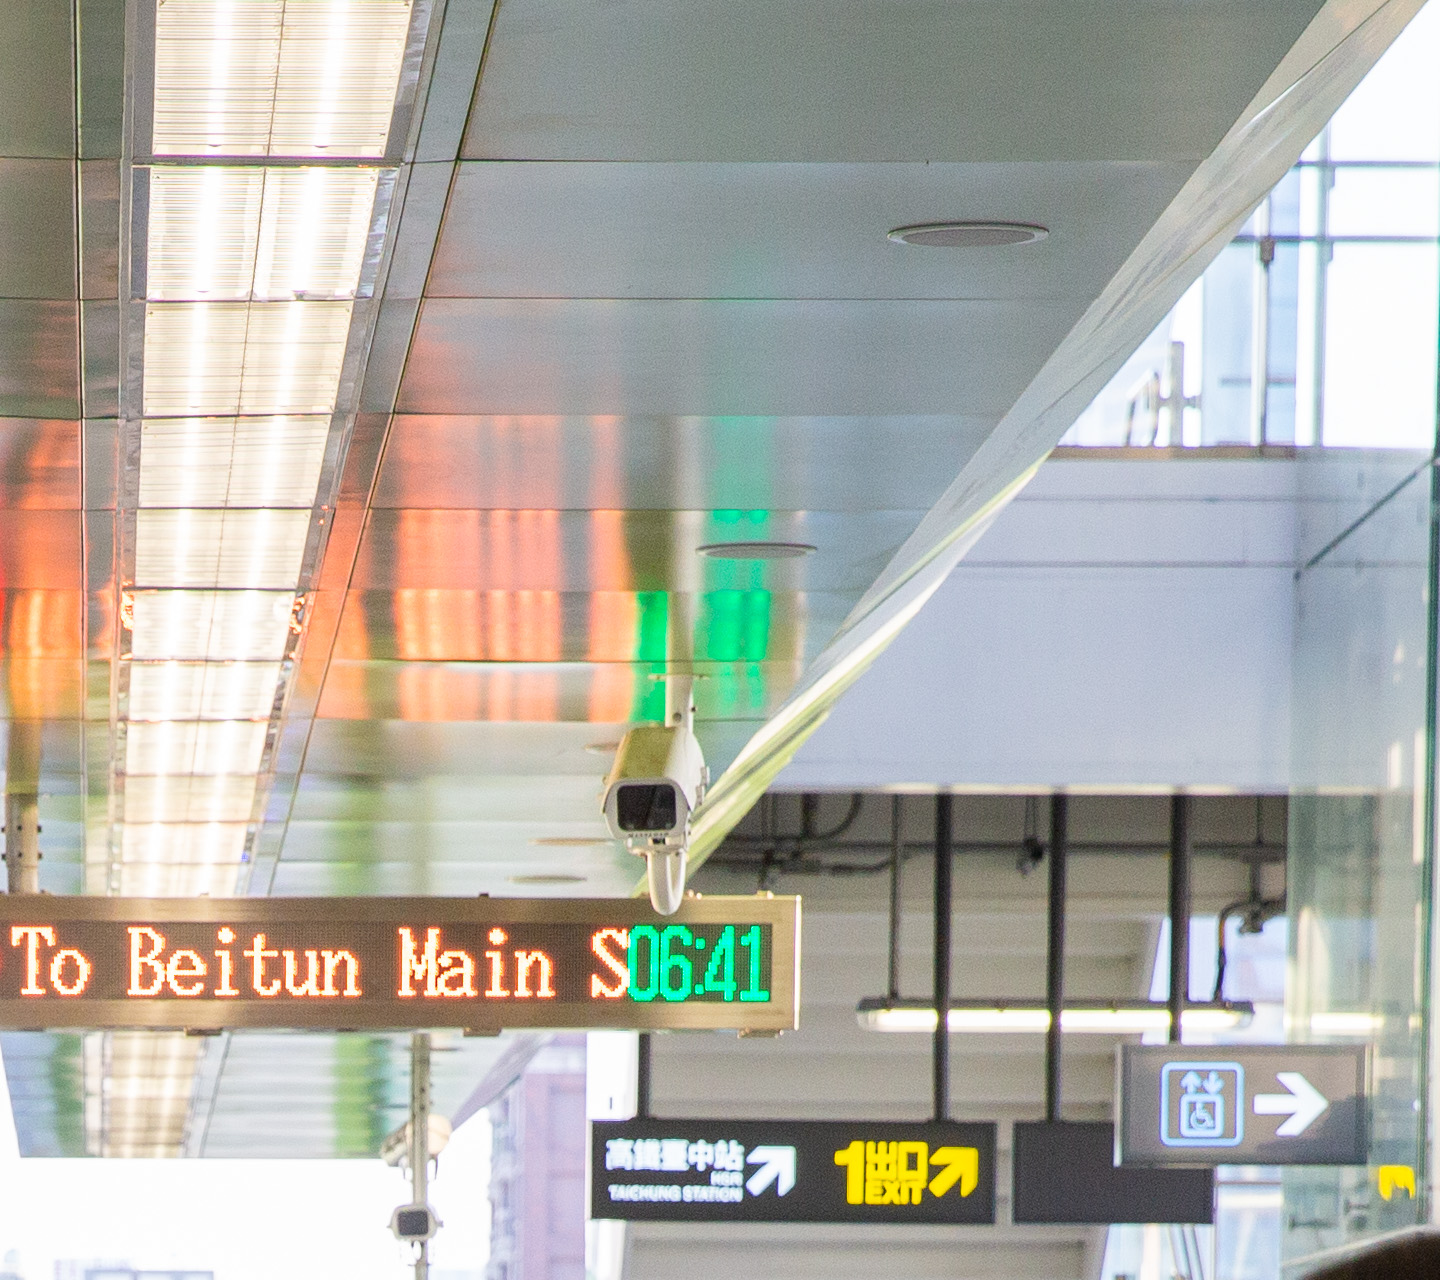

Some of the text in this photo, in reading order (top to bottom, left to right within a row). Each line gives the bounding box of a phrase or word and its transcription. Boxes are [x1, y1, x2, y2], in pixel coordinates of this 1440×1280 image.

[10, 926, 92, 996] To
[126, 926, 362, 996] Beitun
[398, 927, 556, 998] Main
[627, 925, 770, 1002] 06:41
[866, 1141, 928, 1181] 出口
[608, 1184, 744, 1203] TAICHUNG STATION
[865, 1180, 926, 1205] EXIT
